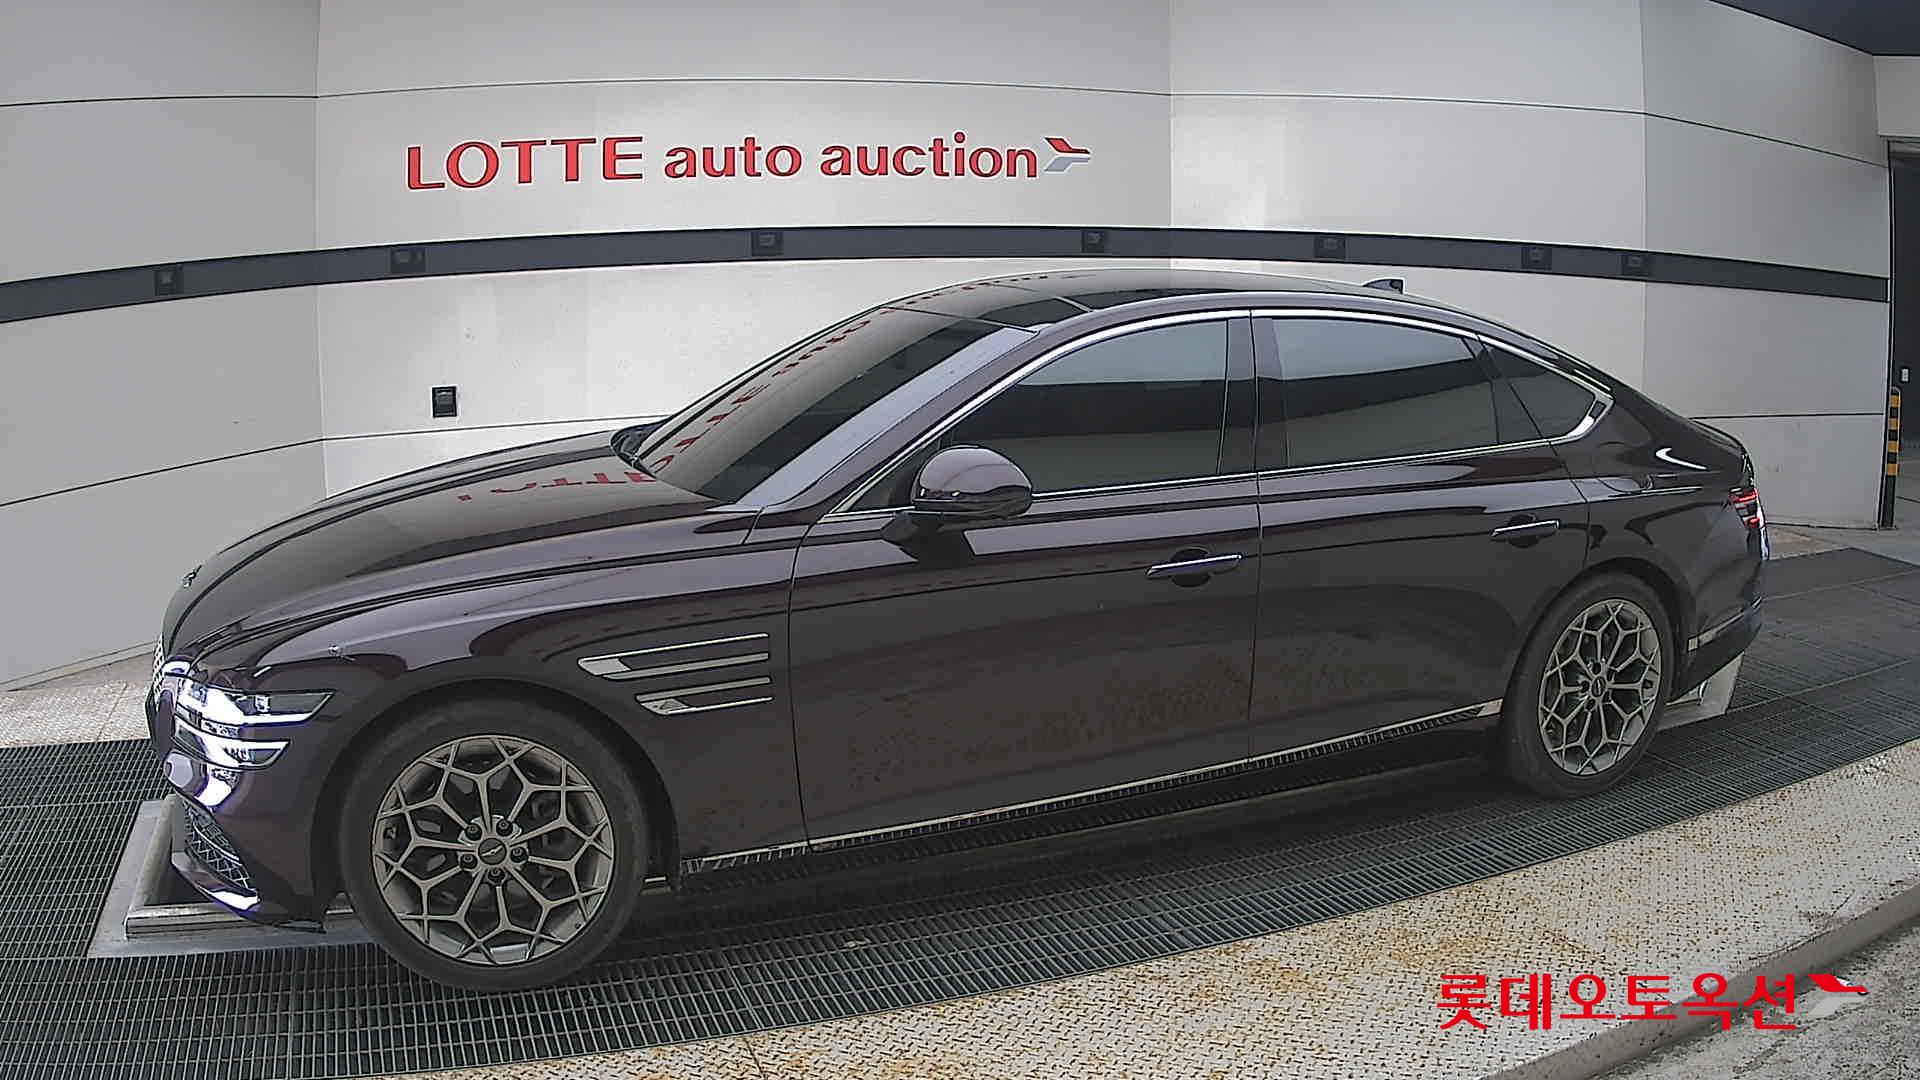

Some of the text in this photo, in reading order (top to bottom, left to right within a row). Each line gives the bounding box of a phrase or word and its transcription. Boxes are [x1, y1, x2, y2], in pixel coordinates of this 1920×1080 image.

[407, 131, 1038, 191] LOTTE auto auction
